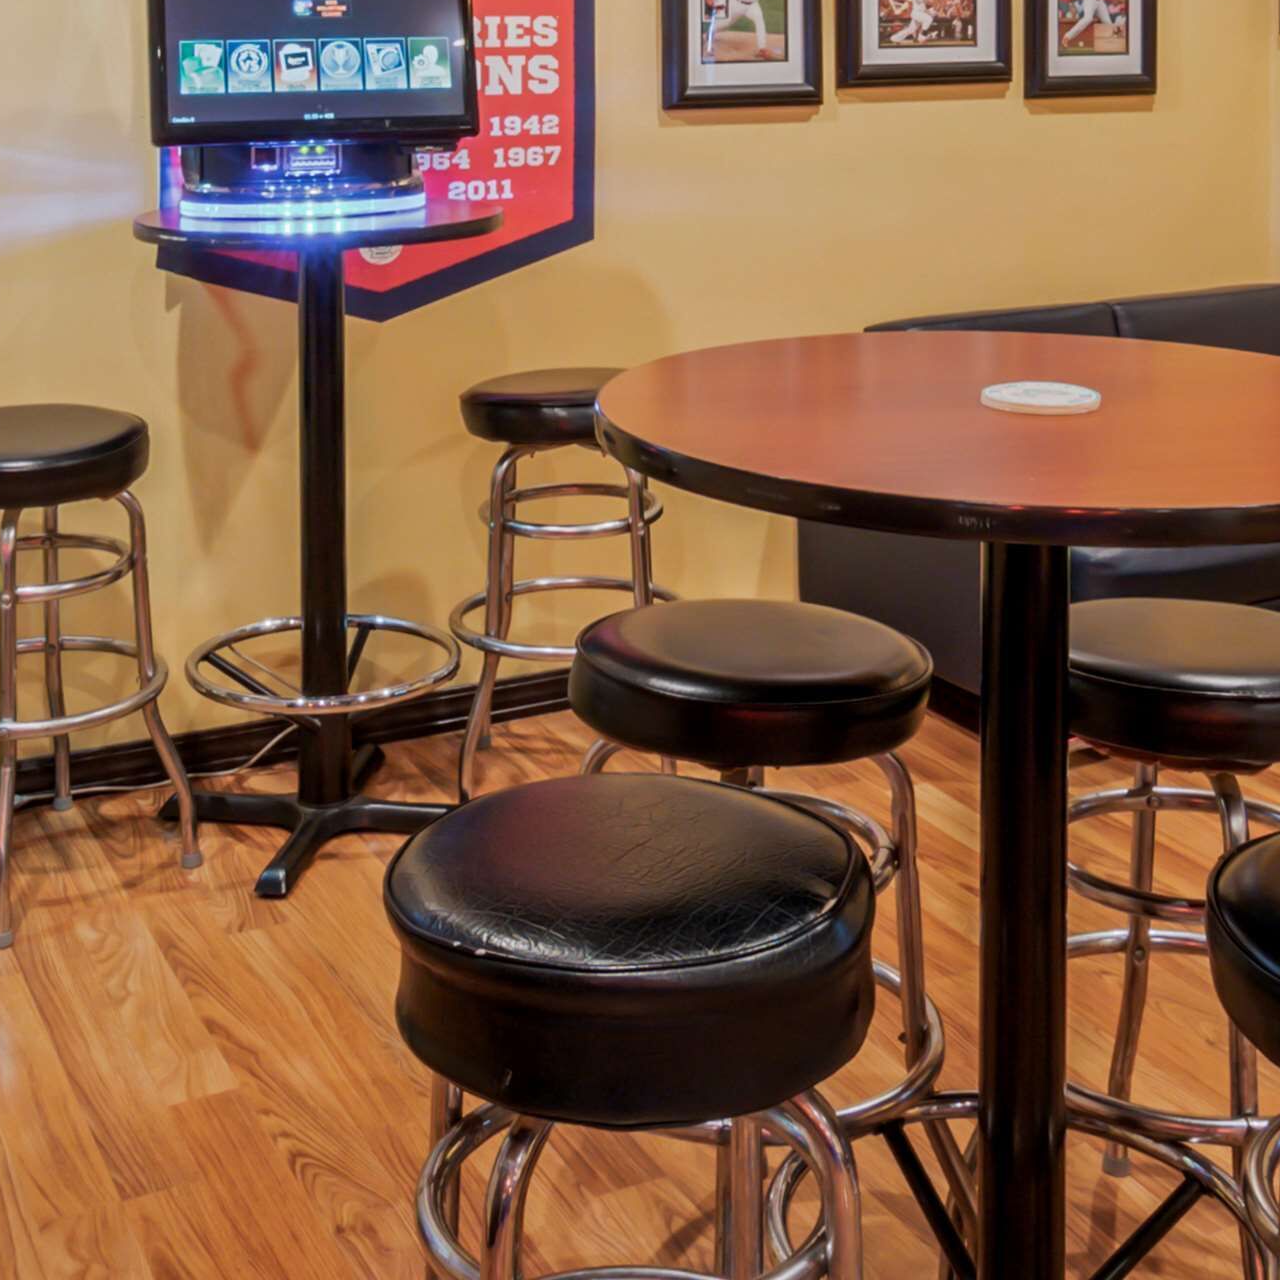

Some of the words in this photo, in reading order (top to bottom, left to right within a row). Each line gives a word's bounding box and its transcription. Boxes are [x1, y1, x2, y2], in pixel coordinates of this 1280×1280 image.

[489, 114, 560, 136] 1942
[416, 148, 470, 171] 964
[494, 146, 561, 168] 1967
[448, 179, 513, 200] 2011
